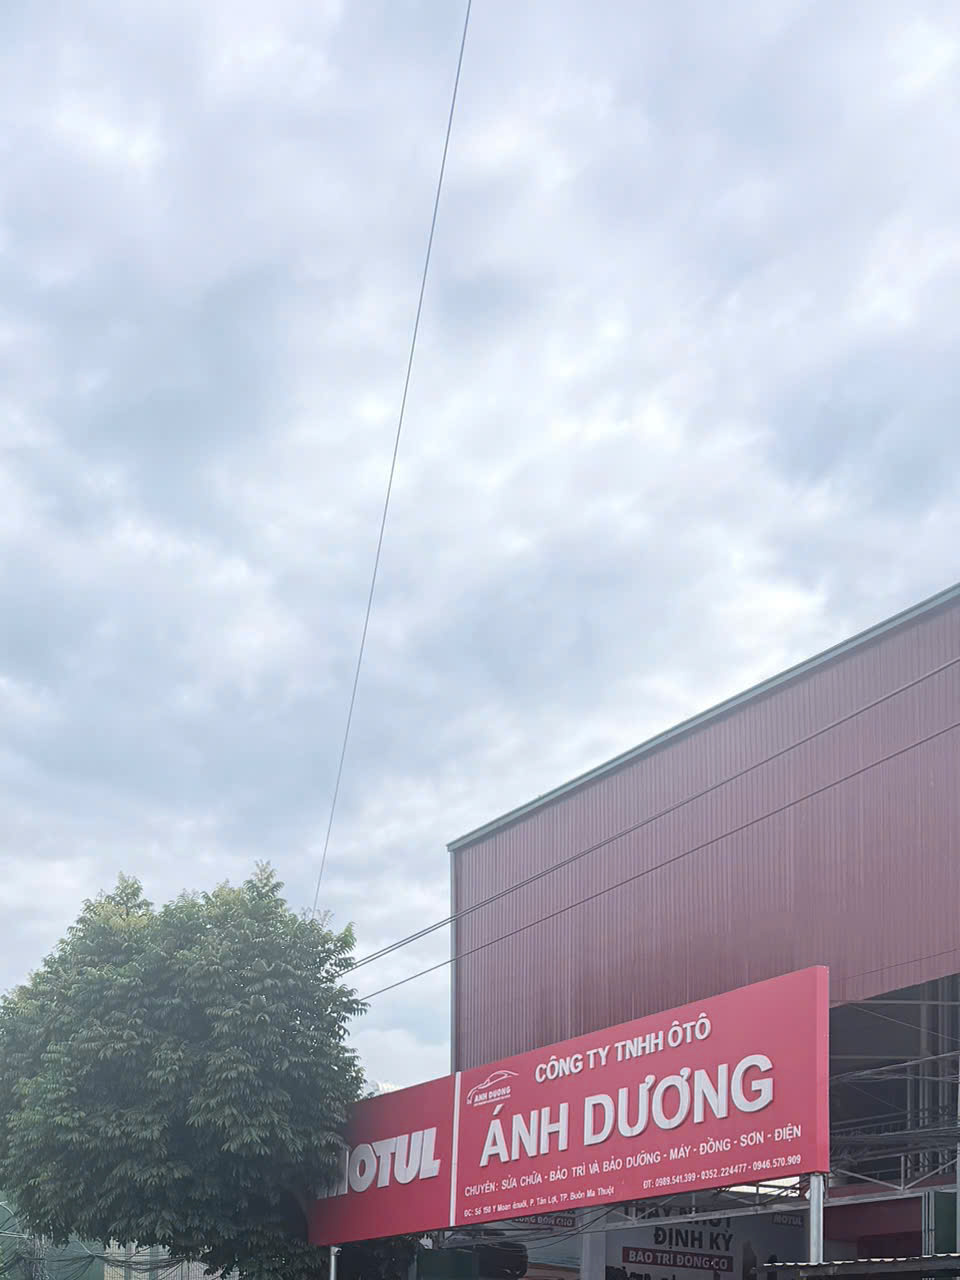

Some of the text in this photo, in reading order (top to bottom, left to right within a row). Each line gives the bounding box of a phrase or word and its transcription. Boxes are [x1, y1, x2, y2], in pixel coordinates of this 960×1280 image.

[535, 1012, 711, 1083] CÔNG TY TNHH ÔTÔ
[479, 1053, 775, 1167] ÁNH DƯƠNG
[464, 1123, 801, 1198] CHUYÊN: SỬA CHỮA BẢO TRÌ VÀ BẢO DƯỠNG MÁY ĐỒNG SƠN ĐIỆN
[654, 1227, 734, 1252] ĐỊNH KỲ
